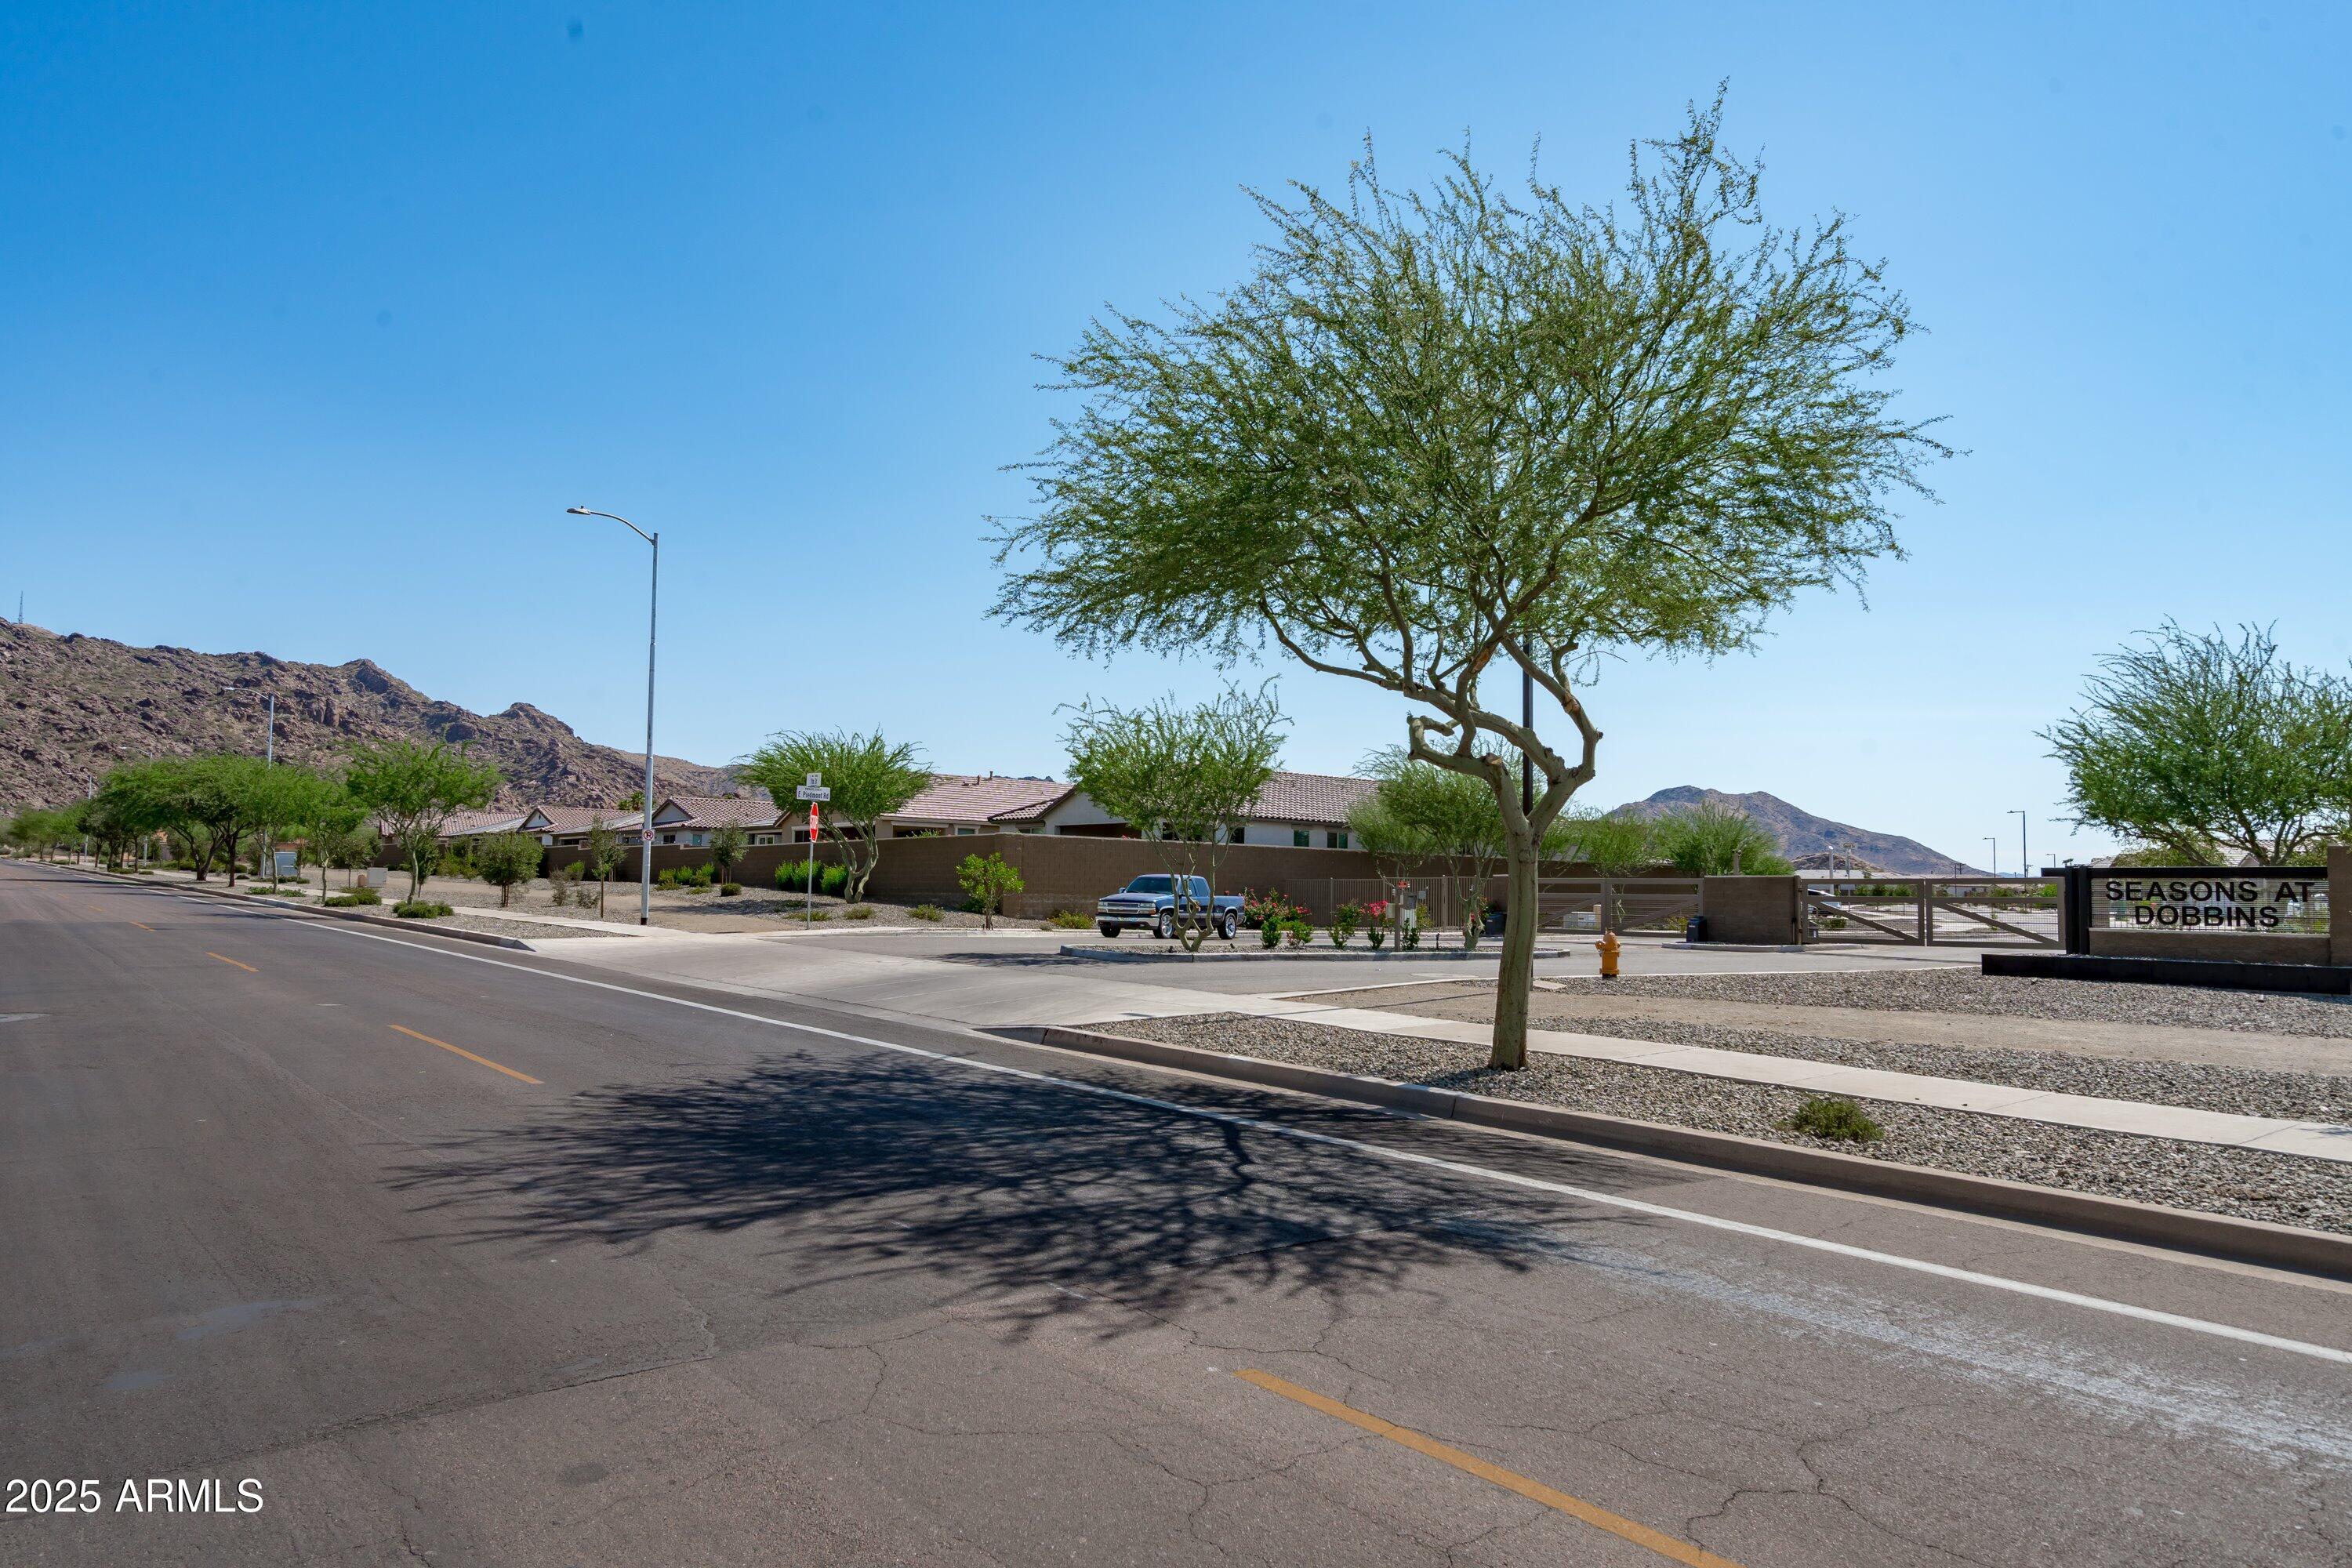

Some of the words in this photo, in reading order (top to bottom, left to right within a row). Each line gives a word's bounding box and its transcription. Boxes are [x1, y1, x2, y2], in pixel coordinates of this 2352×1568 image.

[2106, 881, 2258, 902] SEASONS
[2274, 882, 2315, 902] AT
[2136, 906, 2279, 927] DOBBINS
